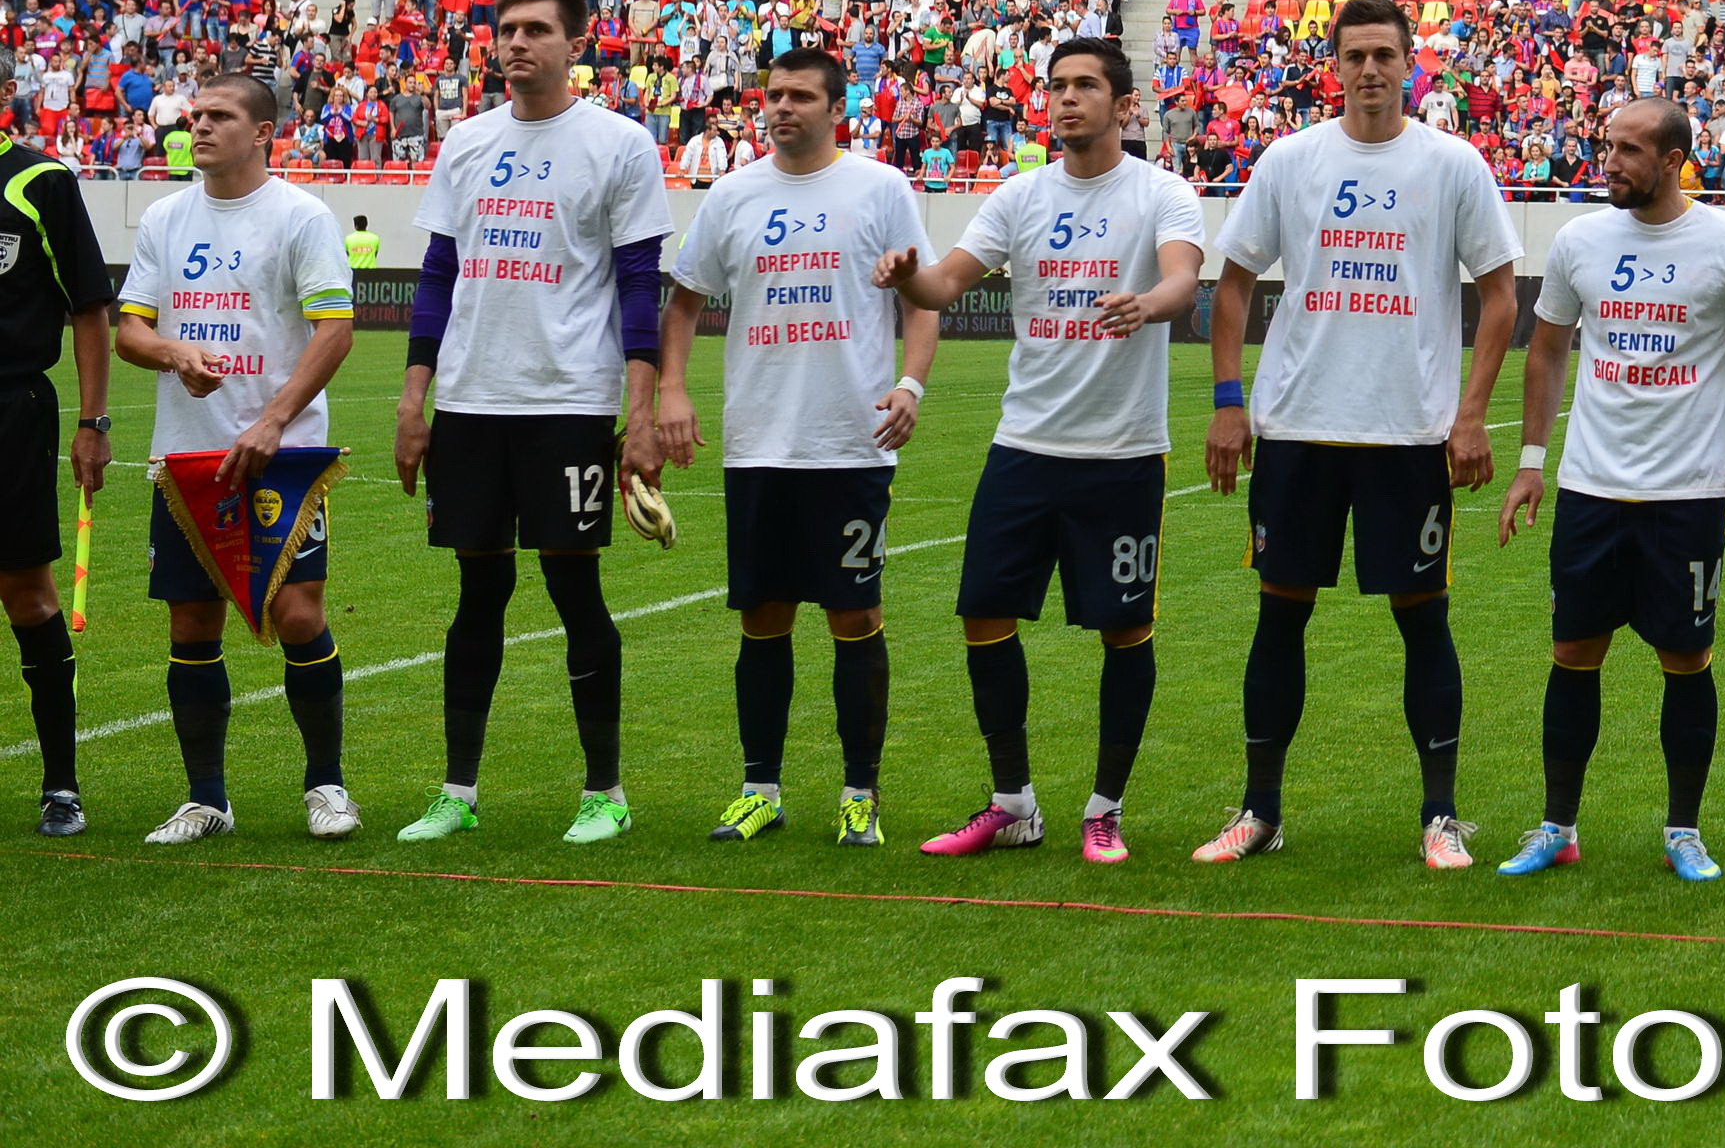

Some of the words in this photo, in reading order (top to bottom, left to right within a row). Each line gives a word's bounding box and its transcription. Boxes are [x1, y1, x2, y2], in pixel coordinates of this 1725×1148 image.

[490, 151, 516, 187] 5
[537, 161, 551, 180] 3
[478, 198, 555, 220] DREPTATE
[1333, 180, 1358, 218] 5
[1383, 189, 1396, 210] 3
[483, 228, 541, 249] PENTRU
[764, 209, 788, 246] 5
[813, 213, 826, 232] 3
[1049, 212, 1074, 250] 5
[1096, 218, 1107, 238] 3
[1320, 229, 1405, 251] DREPTATE
[183, 243, 211, 280] 5
[228, 251, 241, 270] 3
[464, 260, 489, 278] GIGI
[496, 260, 562, 284] BECALI
[757, 252, 839, 273] DREPTATE
[1039, 260, 1118, 278] DREPTATE
[1332, 260, 1397, 282] PENTRU
[1611, 255, 1637, 292] 5
[1662, 264, 1675, 284] 3
[173, 292, 251, 310] DREPTATE
[767, 285, 832, 304] PENTRU
[1306, 292, 1341, 311] GIGI
[1349, 292, 1417, 316] BECALI
[1600, 300, 1687, 322] DREPTATE
[180, 324, 240, 341] PENTRU
[749, 325, 779, 346] GIGI
[787, 320, 851, 344] BECALI
[1029, 318, 1059, 338] GIGI
[1608, 332, 1675, 352] PENTRU
[1595, 359, 1620, 381] GIGI
[1627, 365, 1697, 386] BECALI
[565, 464, 605, 513] 12
[1420, 505, 1443, 555] 6
[1111, 534, 1157, 584] 80
